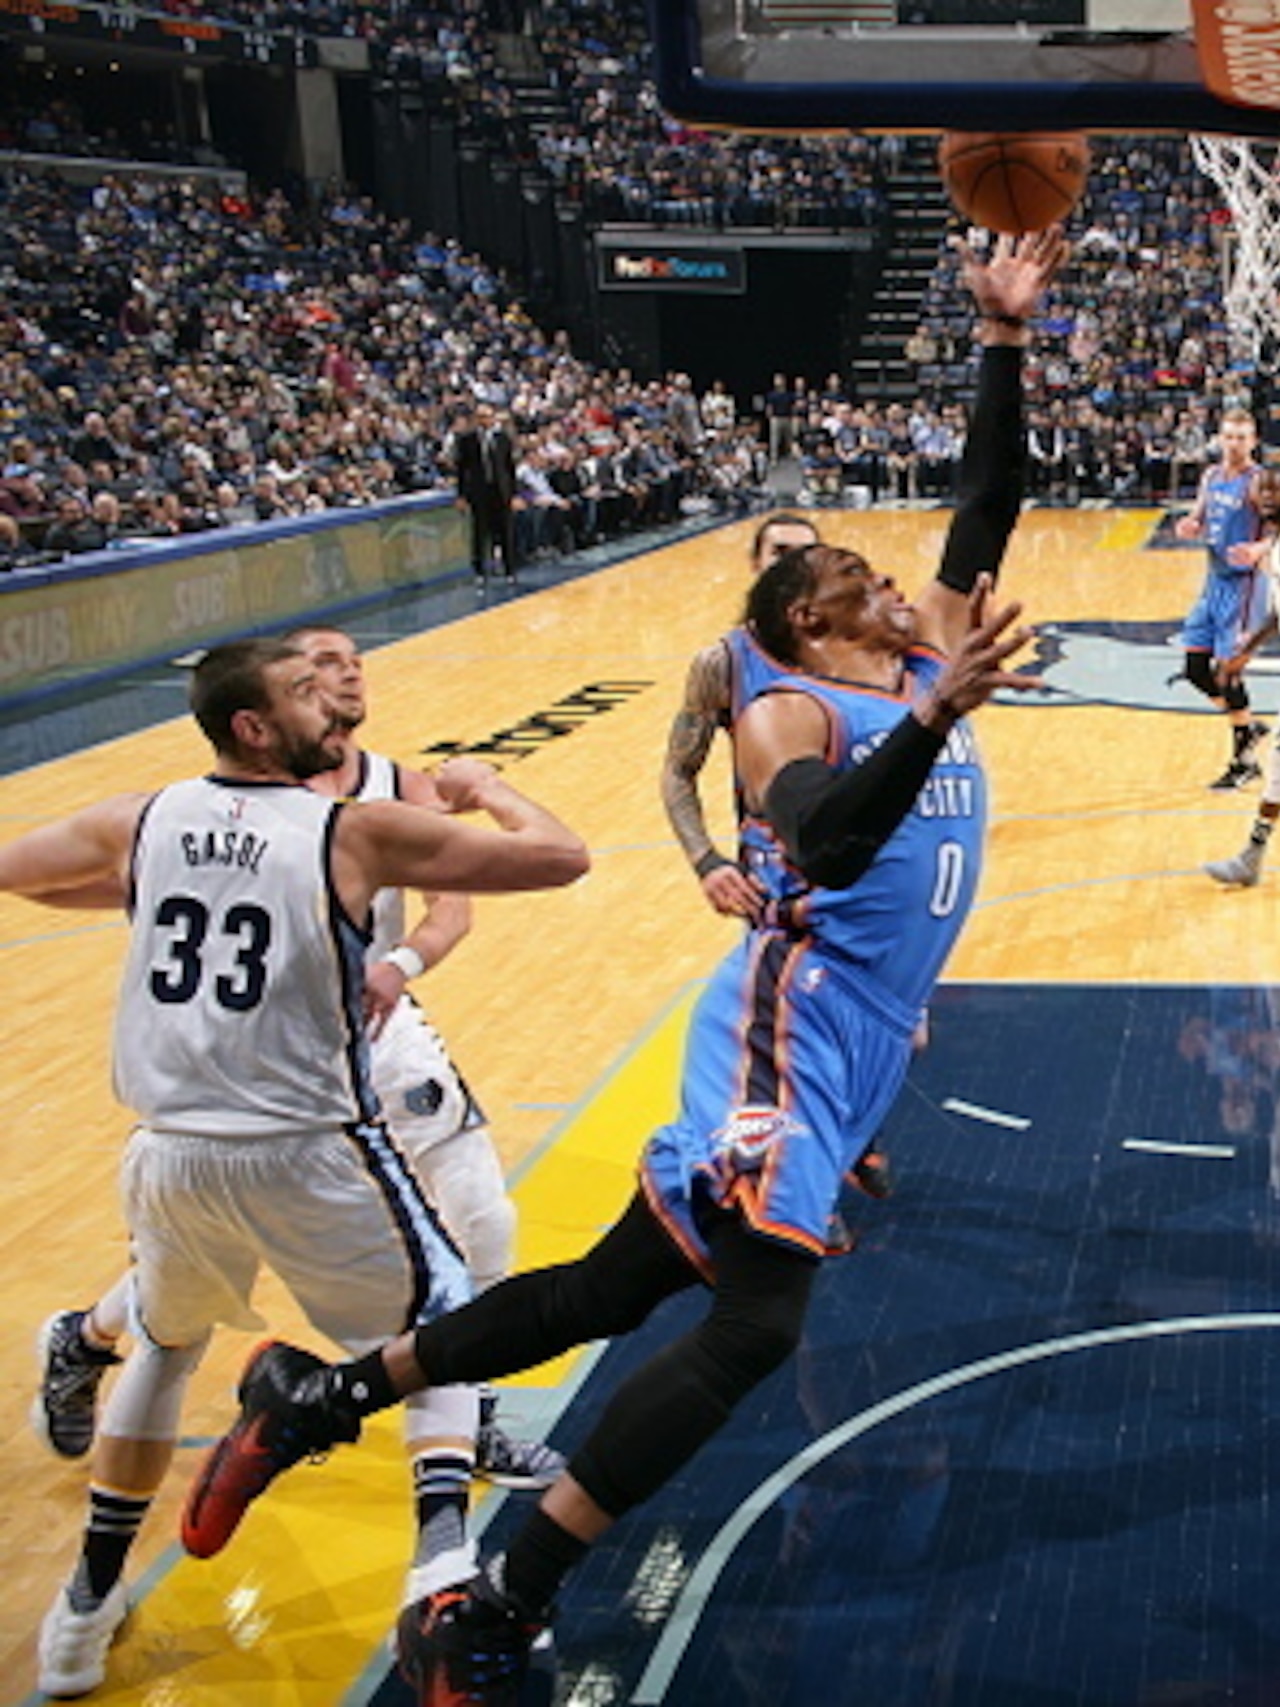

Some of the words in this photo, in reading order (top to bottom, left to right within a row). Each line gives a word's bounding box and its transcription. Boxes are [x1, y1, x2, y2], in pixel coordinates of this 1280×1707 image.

[181, 831, 268, 876] GASOL
[930, 841, 964, 917] 0
[150, 895, 271, 1012] 33
